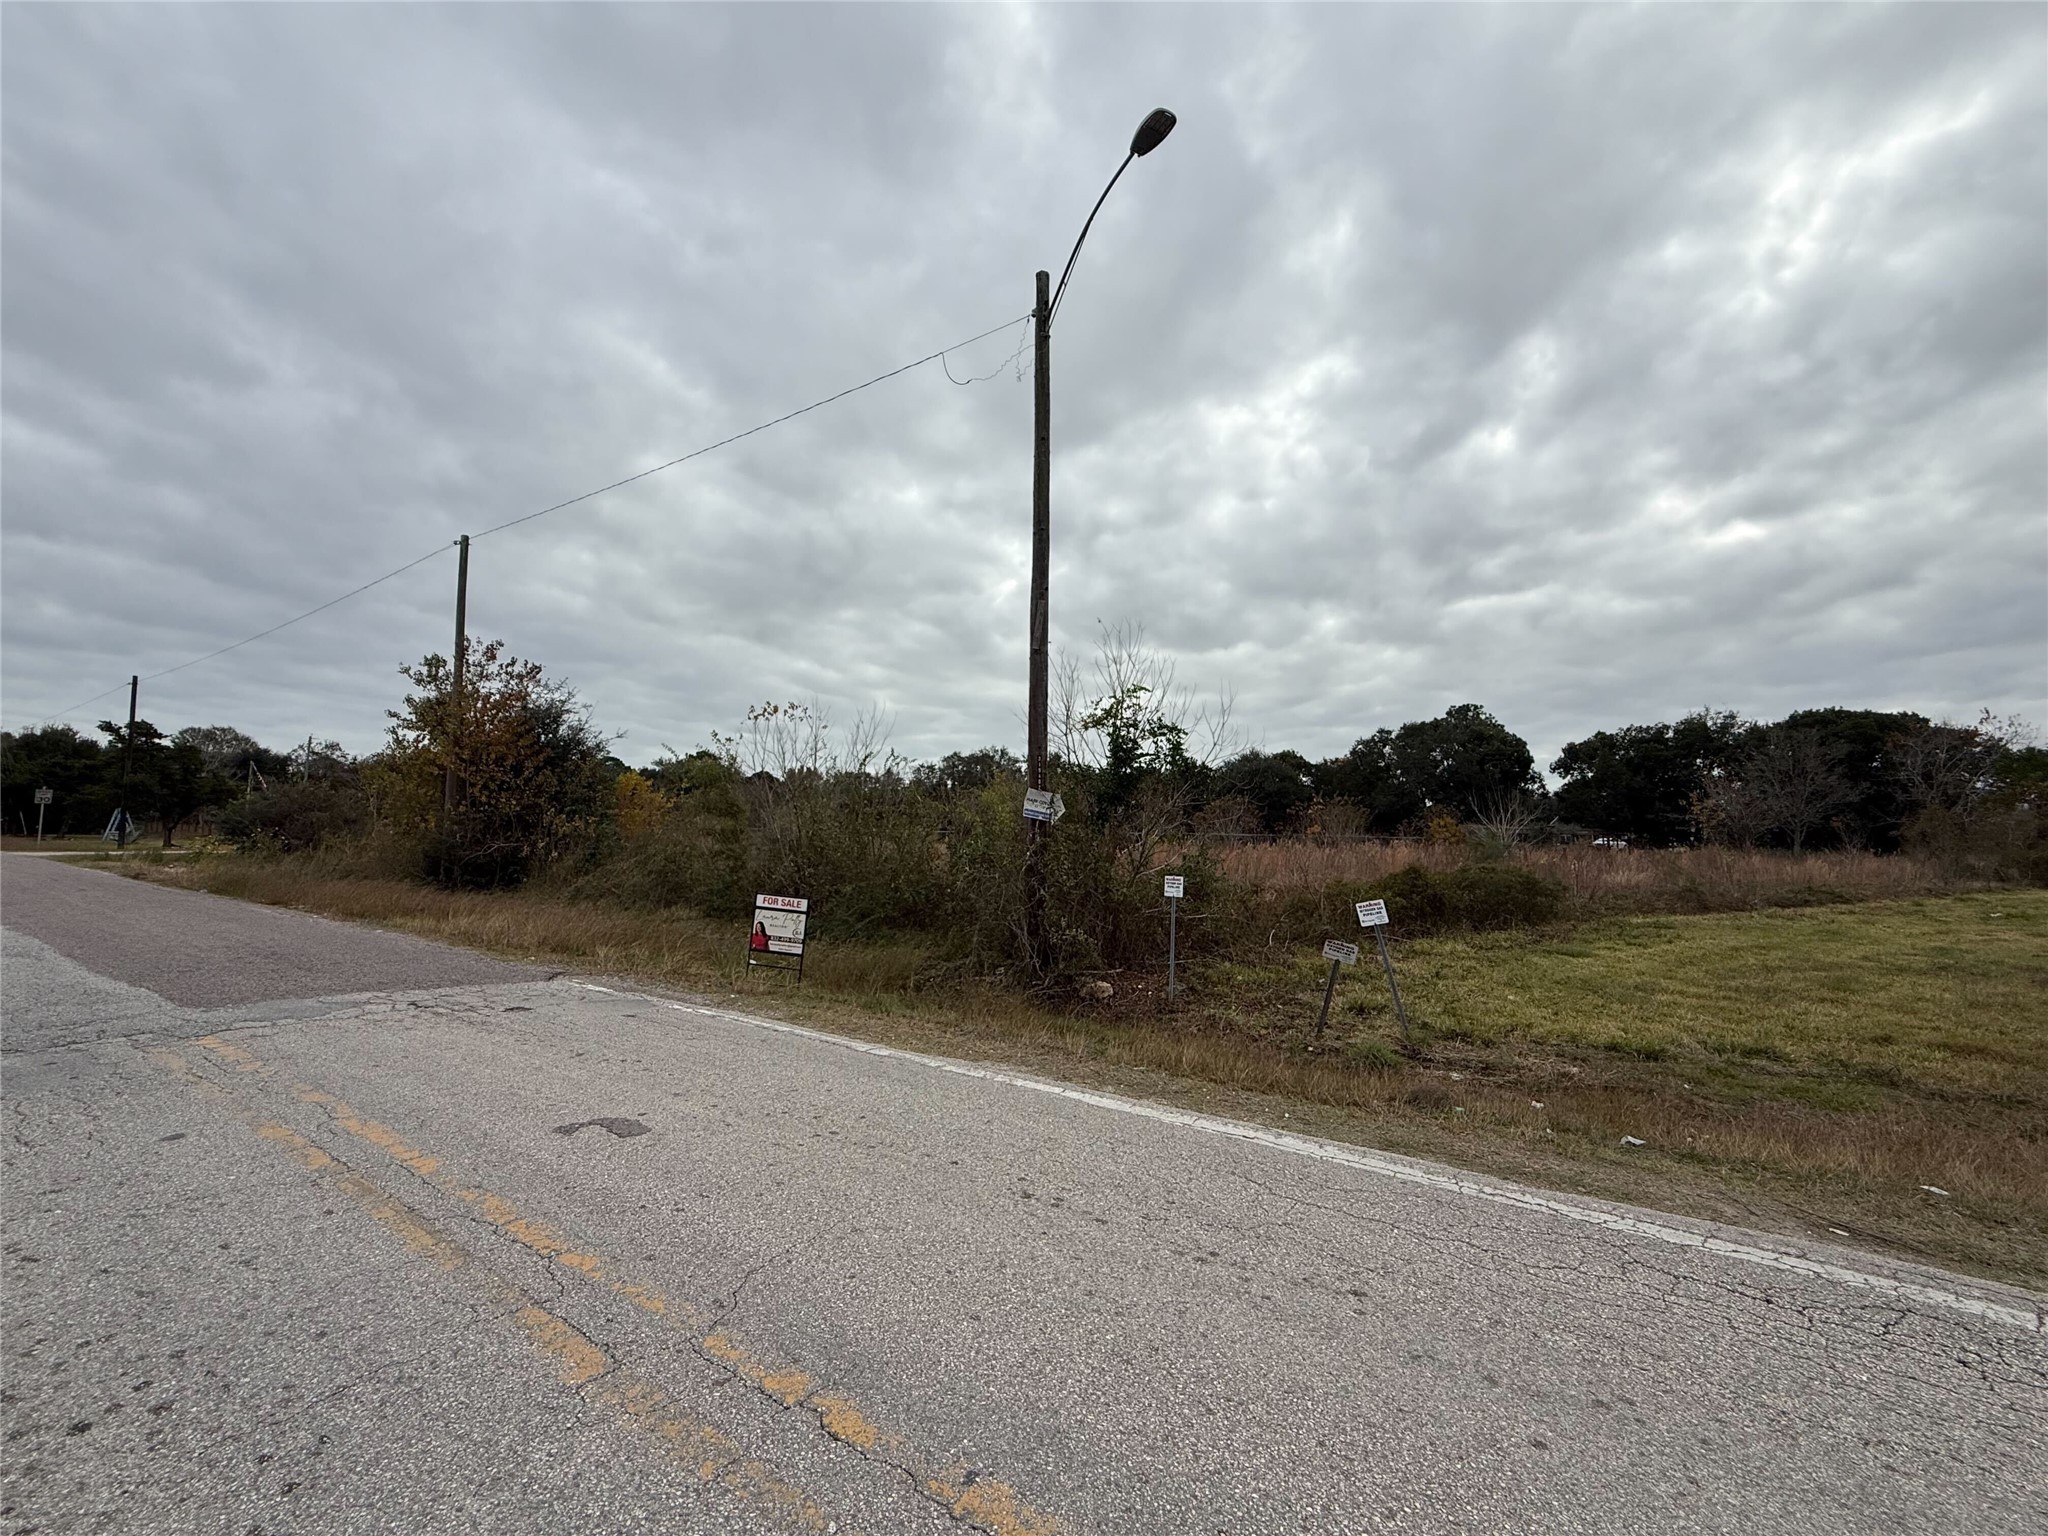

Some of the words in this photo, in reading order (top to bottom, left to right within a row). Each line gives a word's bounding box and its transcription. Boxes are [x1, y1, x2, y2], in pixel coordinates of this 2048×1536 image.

[762, 896, 778, 906] FOR
[781, 898, 802, 909] SALE
[1327, 940, 1354, 950] WARNING
[1328, 948, 1351, 956] PIPELINE
